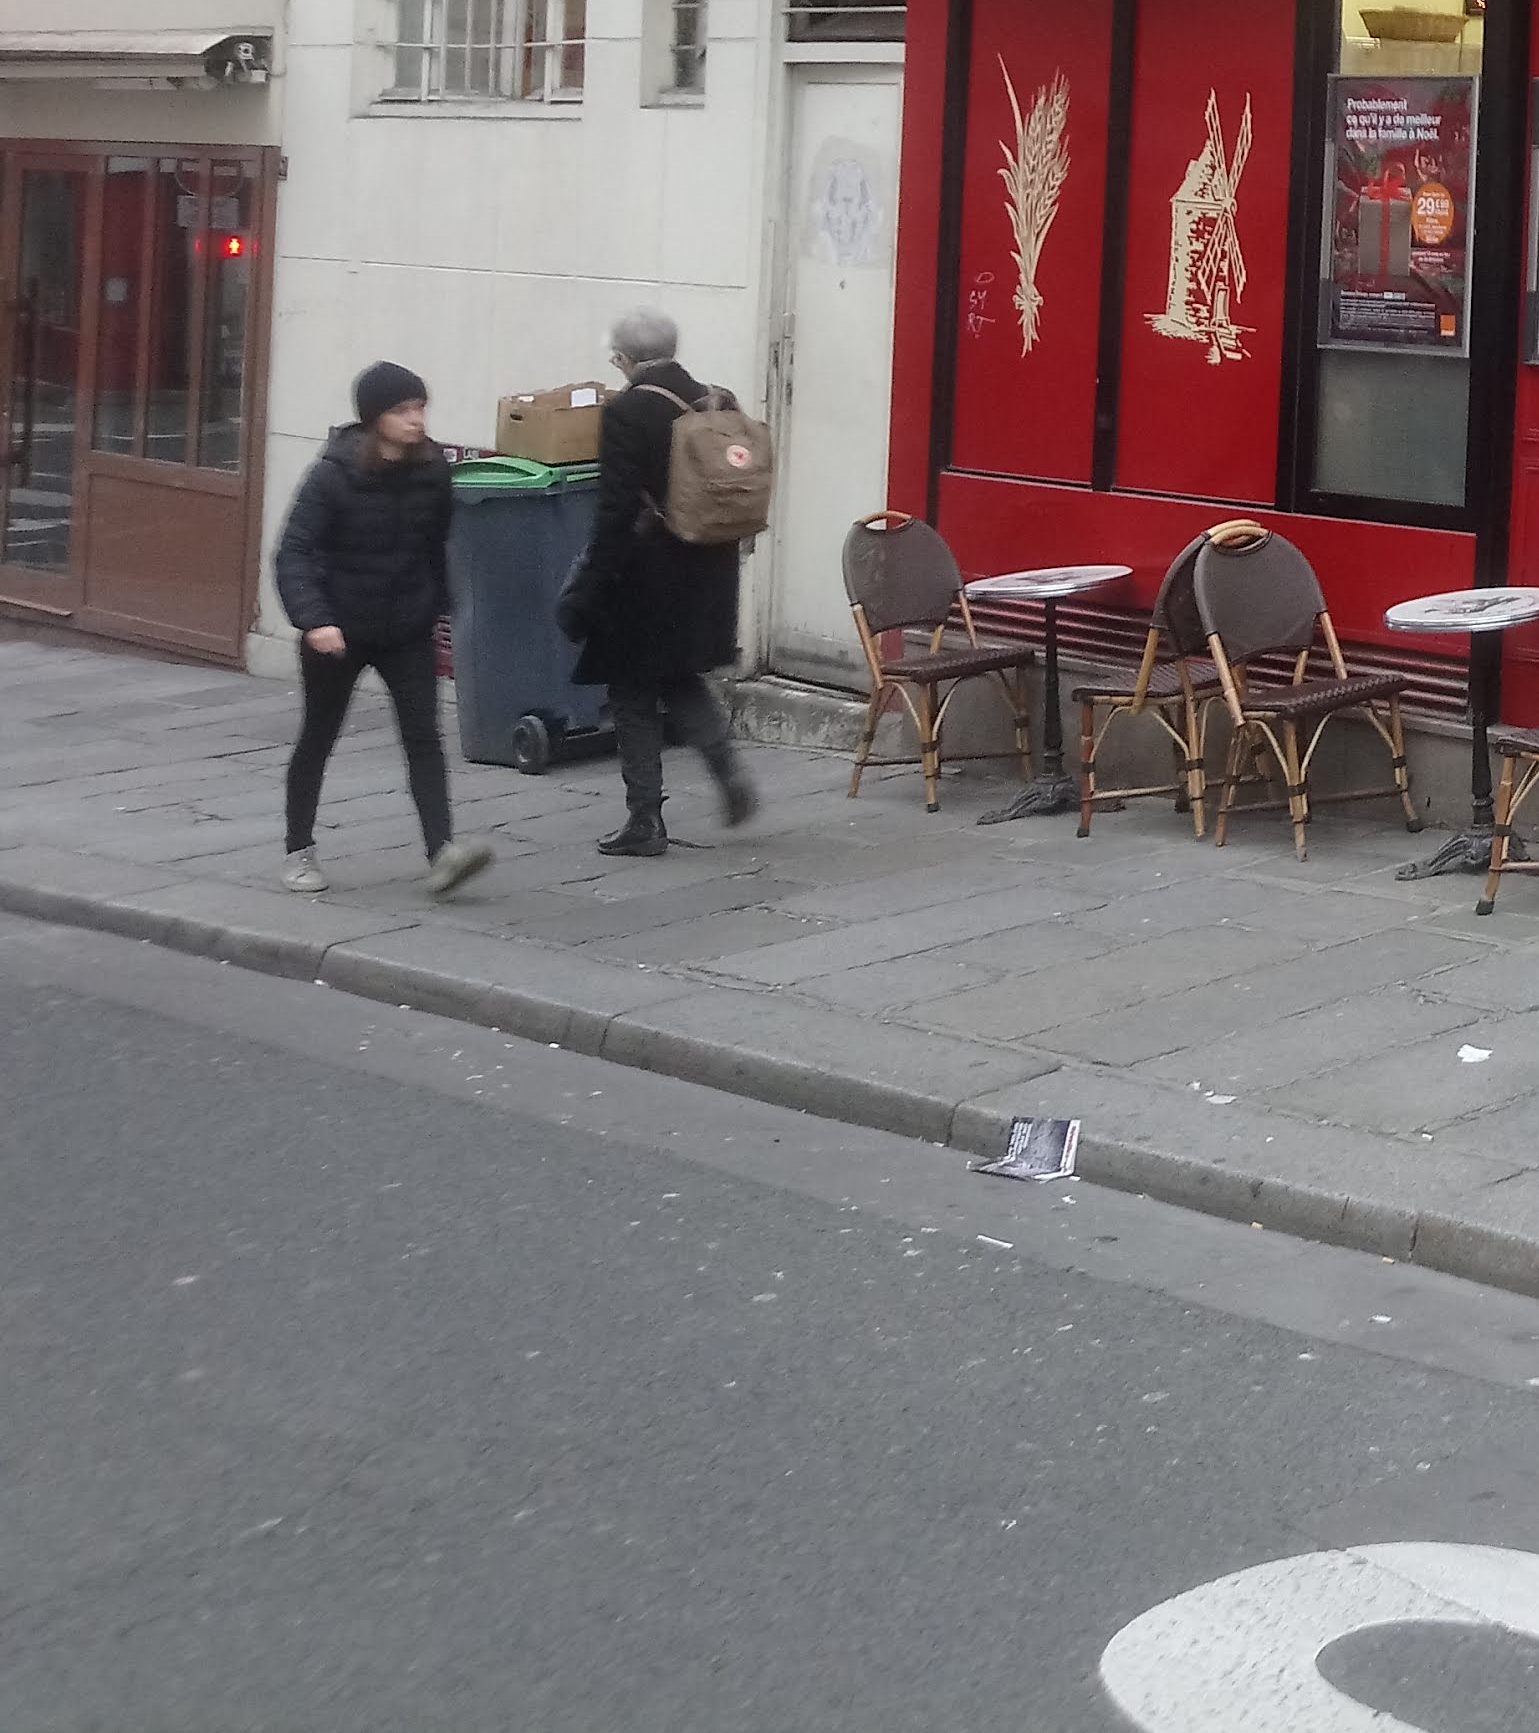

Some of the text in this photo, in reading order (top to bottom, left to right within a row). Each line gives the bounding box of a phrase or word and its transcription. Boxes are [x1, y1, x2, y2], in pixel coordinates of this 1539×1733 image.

[1347, 97, 1407, 111] Probablement
[1406, 113, 1441, 126] meilleur
[1378, 127, 1407, 139] famille
